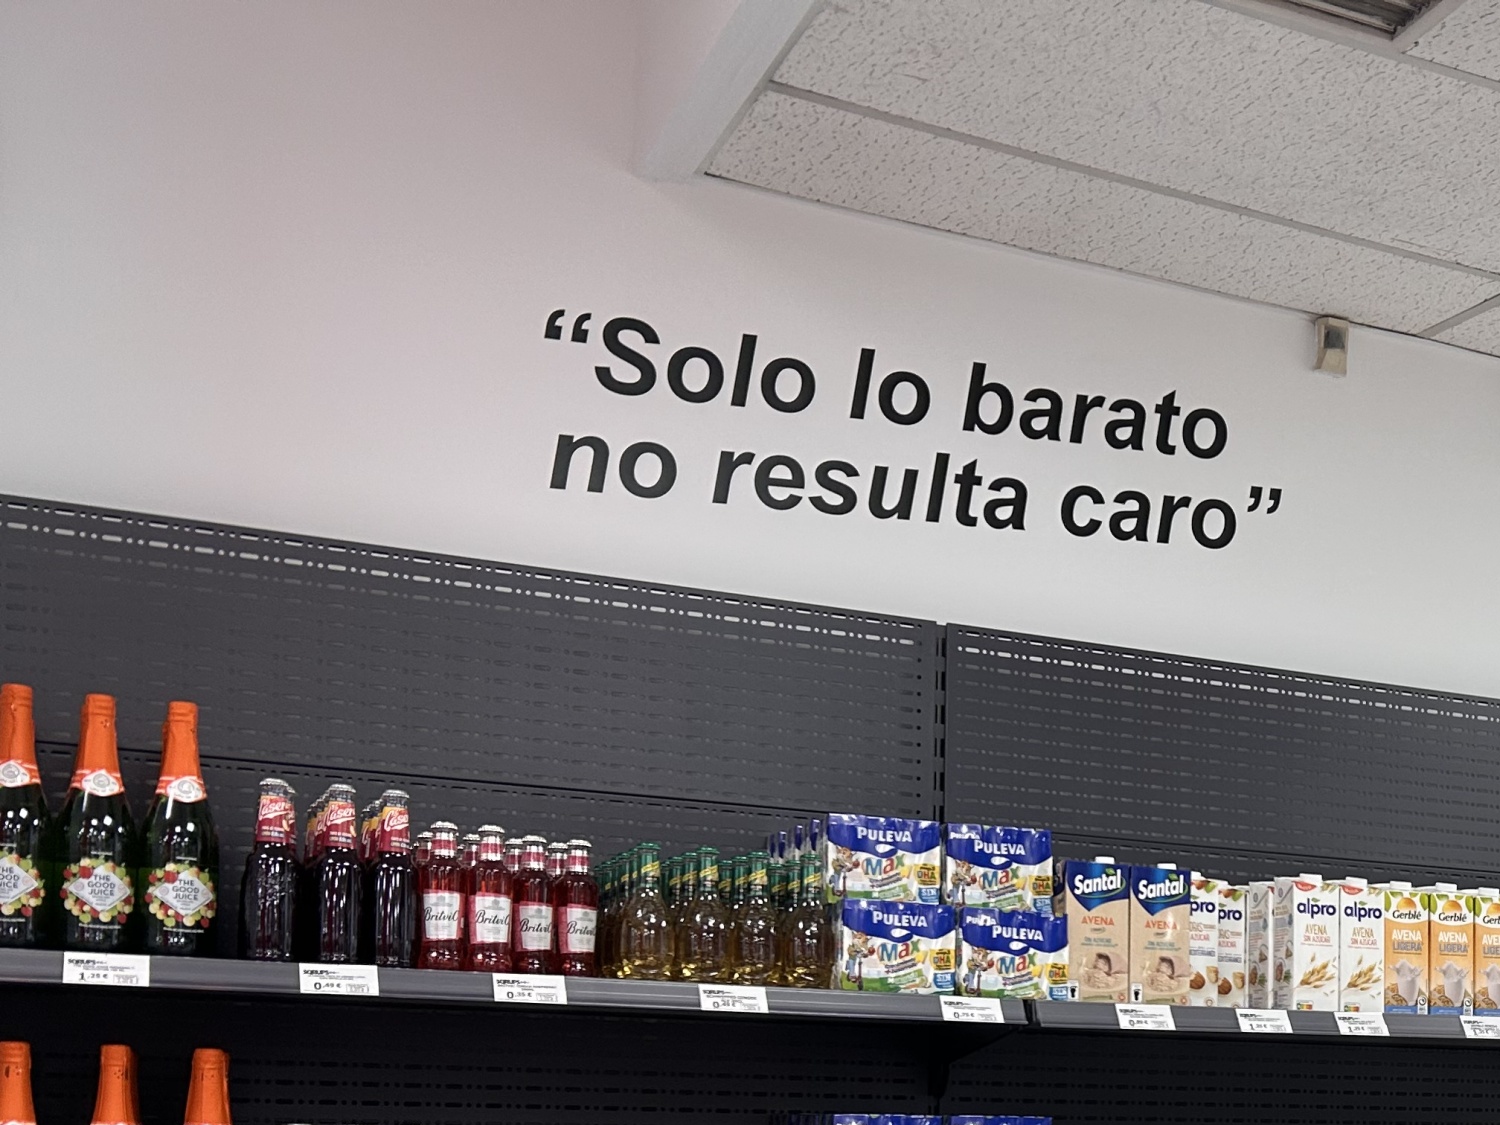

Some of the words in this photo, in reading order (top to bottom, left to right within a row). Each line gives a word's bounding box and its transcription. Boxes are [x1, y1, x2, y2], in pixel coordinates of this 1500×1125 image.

[543, 308, 816, 414] “Solo
[849, 347, 932, 426] lo
[962, 361, 1229, 460] barato
[549, 432, 678, 499] no
[711, 449, 1027, 531] resulta
[1059, 485, 1283, 549] caro”
[856, 826, 912, 843] PULEVA
[973, 839, 1026, 856] PULEVA
[863, 854, 905, 876] Max
[87, 881, 116, 890] GOOD
[1074, 869, 1121, 894] Santal
[1138, 875, 1184, 899] Santal
[90, 888, 115, 897] JUICE
[1297, 898, 1336, 919] alpro
[872, 910, 928, 928] PULEVA
[1081, 916, 1115, 926] AVENA
